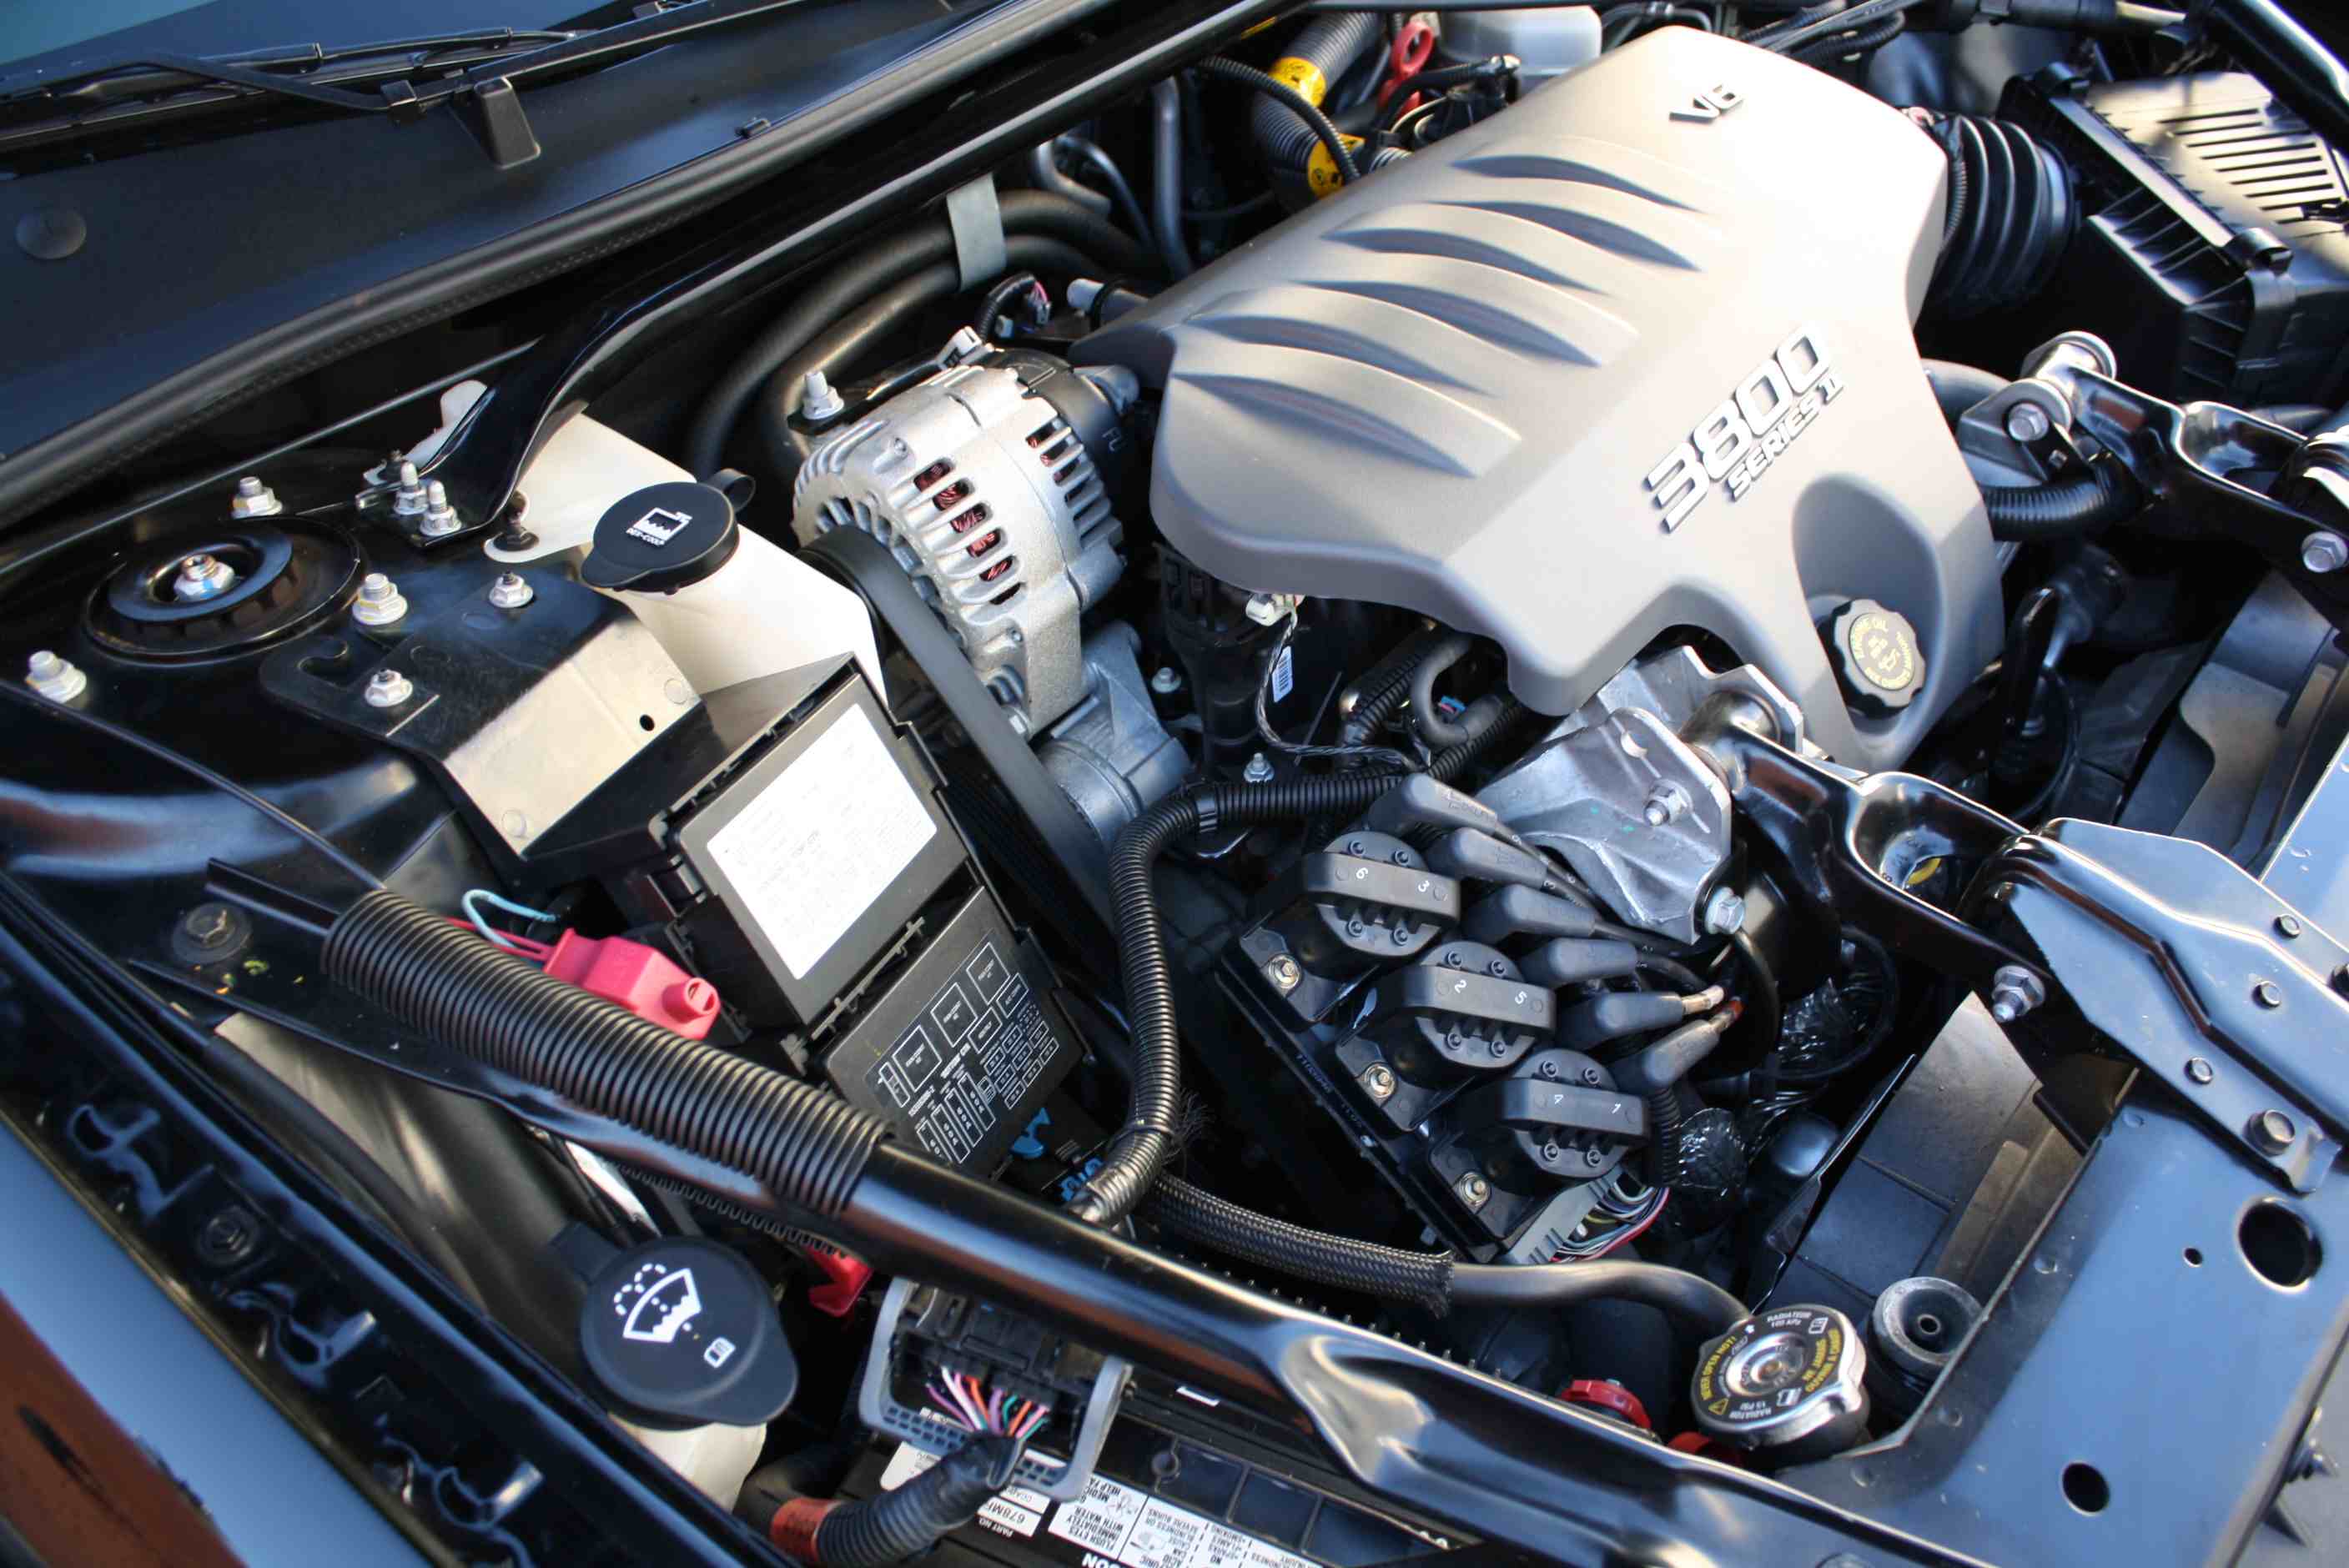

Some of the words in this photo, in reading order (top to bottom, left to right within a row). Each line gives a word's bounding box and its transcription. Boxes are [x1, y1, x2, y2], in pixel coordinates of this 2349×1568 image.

[1669, 82, 1744, 124] V6
[1643, 325, 1831, 533] 3800
[1723, 397, 1822, 501] SERIES
[1356, 867, 1368, 879] 6
[1418, 880, 1430, 892] 3
[1454, 979, 1466, 993] 2
[1514, 990, 1527, 1004] 5
[992, 1523, 1014, 1538] PART
[1067, 1514, 1120, 1541] IMMEDIATELY
[1068, 1525, 1089, 1540] EYES
[1101, 1515, 1124, 1532] WITH
[1210, 1554, 1223, 1565] NO
